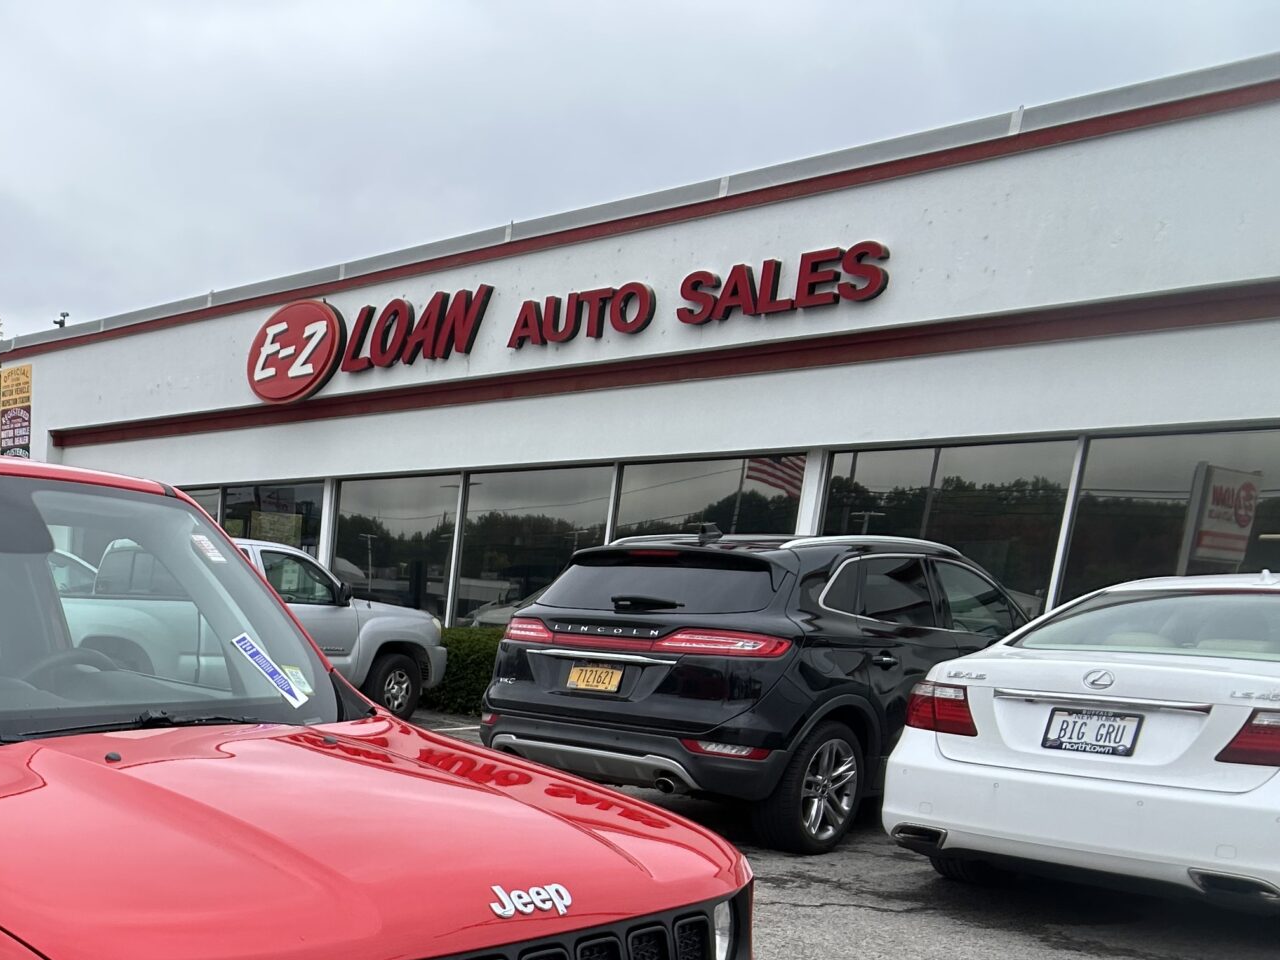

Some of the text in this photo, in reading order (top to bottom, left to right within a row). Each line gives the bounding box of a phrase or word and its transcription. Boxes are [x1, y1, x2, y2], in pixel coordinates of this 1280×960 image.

[252, 240, 891, 382] E-Z LOAN AUTO SALES
[554, 623, 659, 636] LINCOLN
[576, 669, 614, 685] 7121621
[947, 670, 987, 680] LEXUS
[1058, 719, 1126, 744] BIG GRU
[1061, 741, 1113, 754] northtown
[489, 882, 572, 919] Jeep
